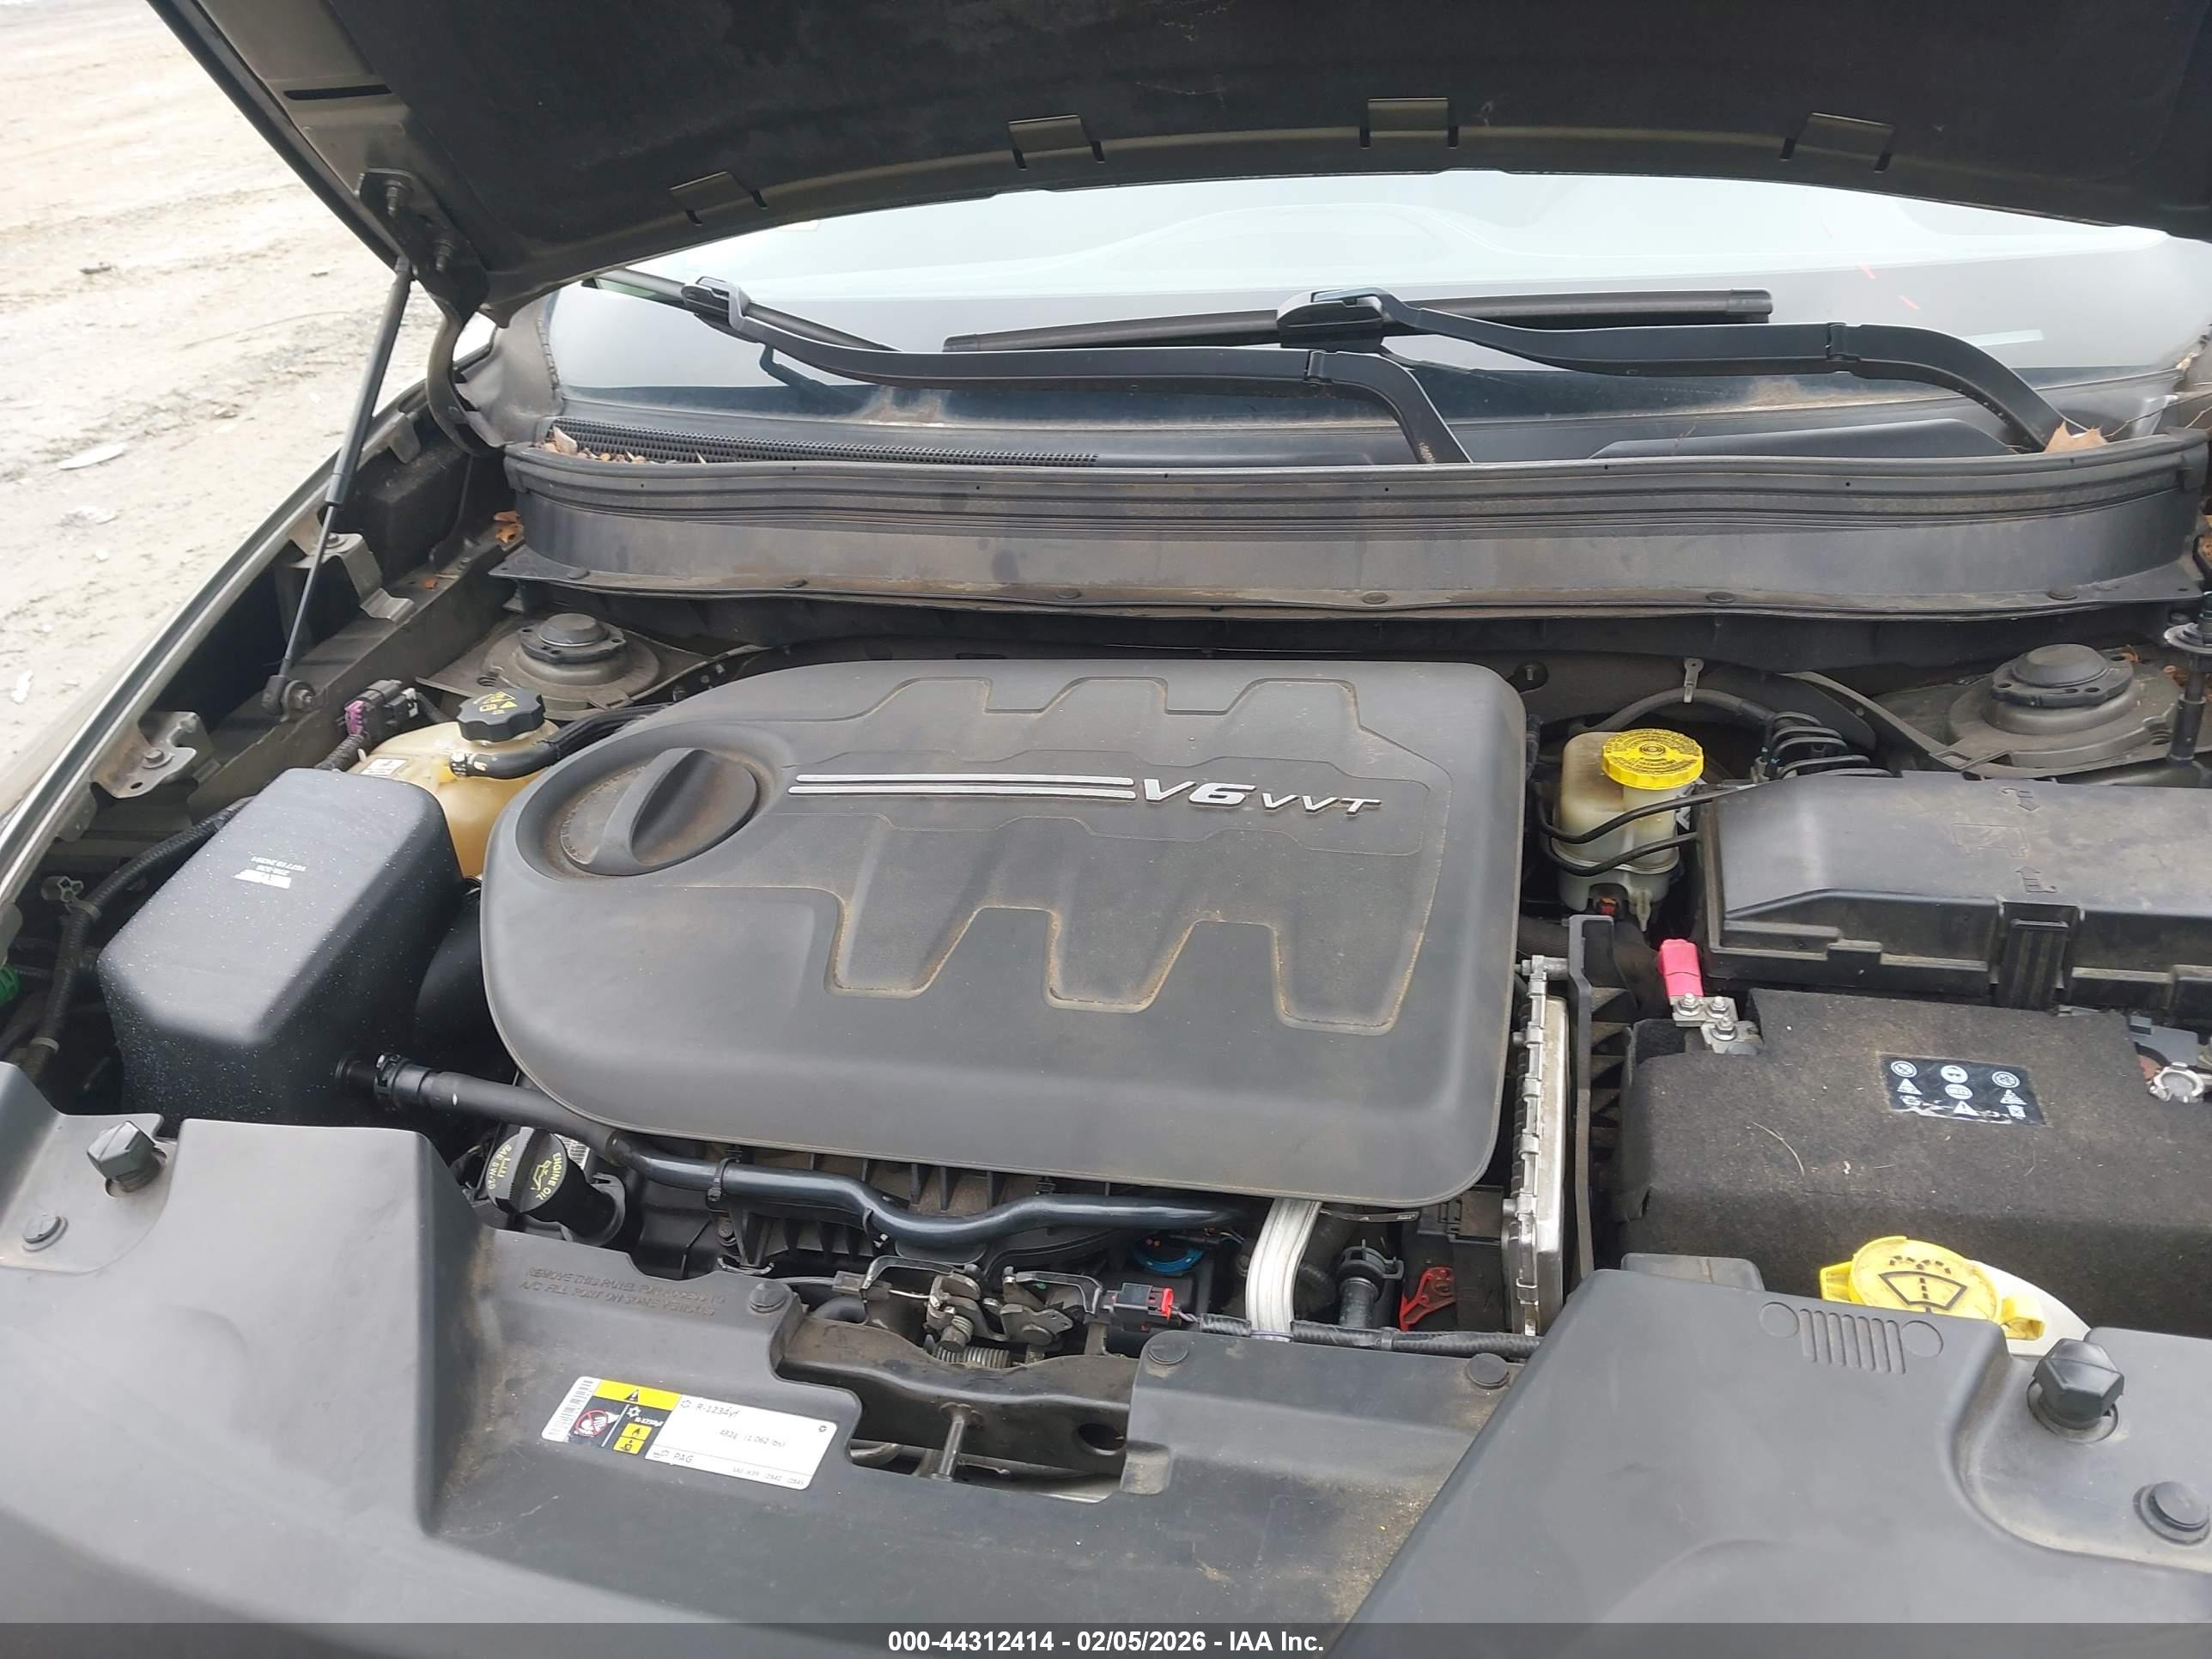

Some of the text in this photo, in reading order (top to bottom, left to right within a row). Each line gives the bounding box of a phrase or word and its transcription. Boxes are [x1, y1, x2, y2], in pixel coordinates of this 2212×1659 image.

[1143, 778, 1382, 815] V6 VVT
[497, 1144, 513, 1161] SAE
[536, 1152, 562, 1200] ENGINE OIL
[696, 1403, 741, 1418] R-1234yf
[672, 1452, 694, 1464] PAG
